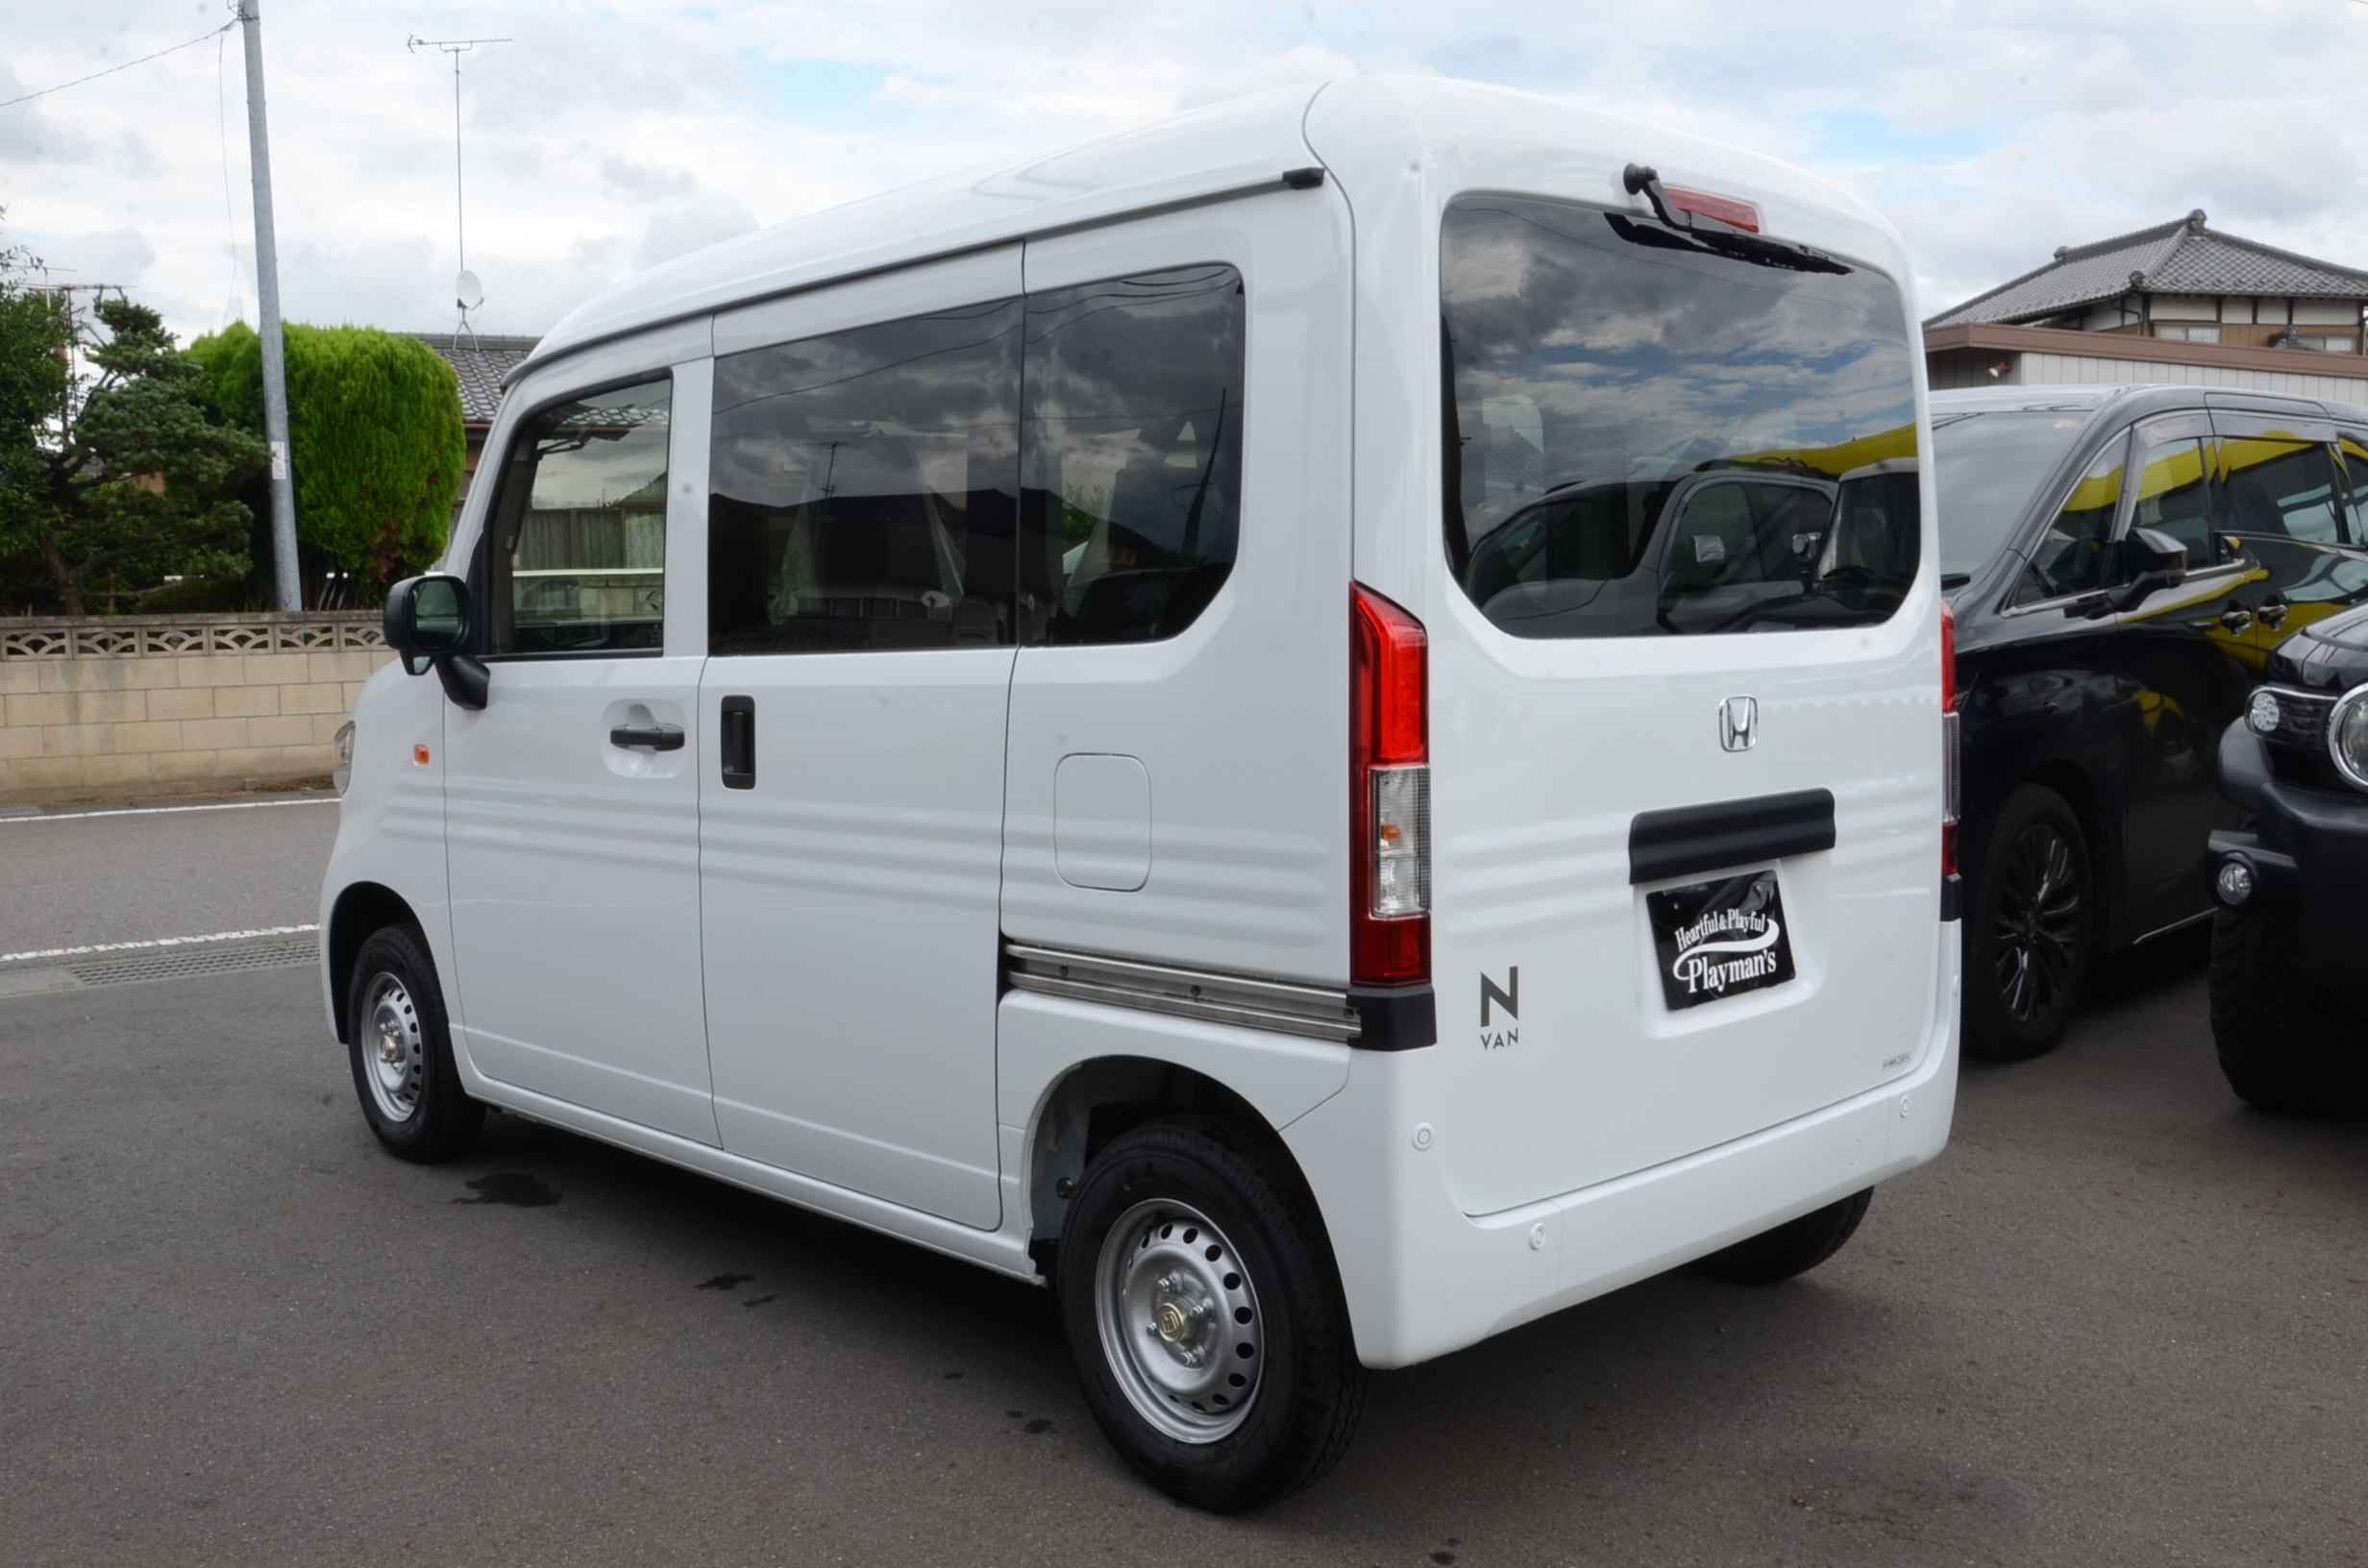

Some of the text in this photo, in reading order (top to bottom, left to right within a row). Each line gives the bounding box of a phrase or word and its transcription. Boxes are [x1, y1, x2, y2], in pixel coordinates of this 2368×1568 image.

[1688, 948, 1777, 993] Playman's
[1480, 965, 1518, 1028] N
[1480, 1027, 1518, 1051] VAN
